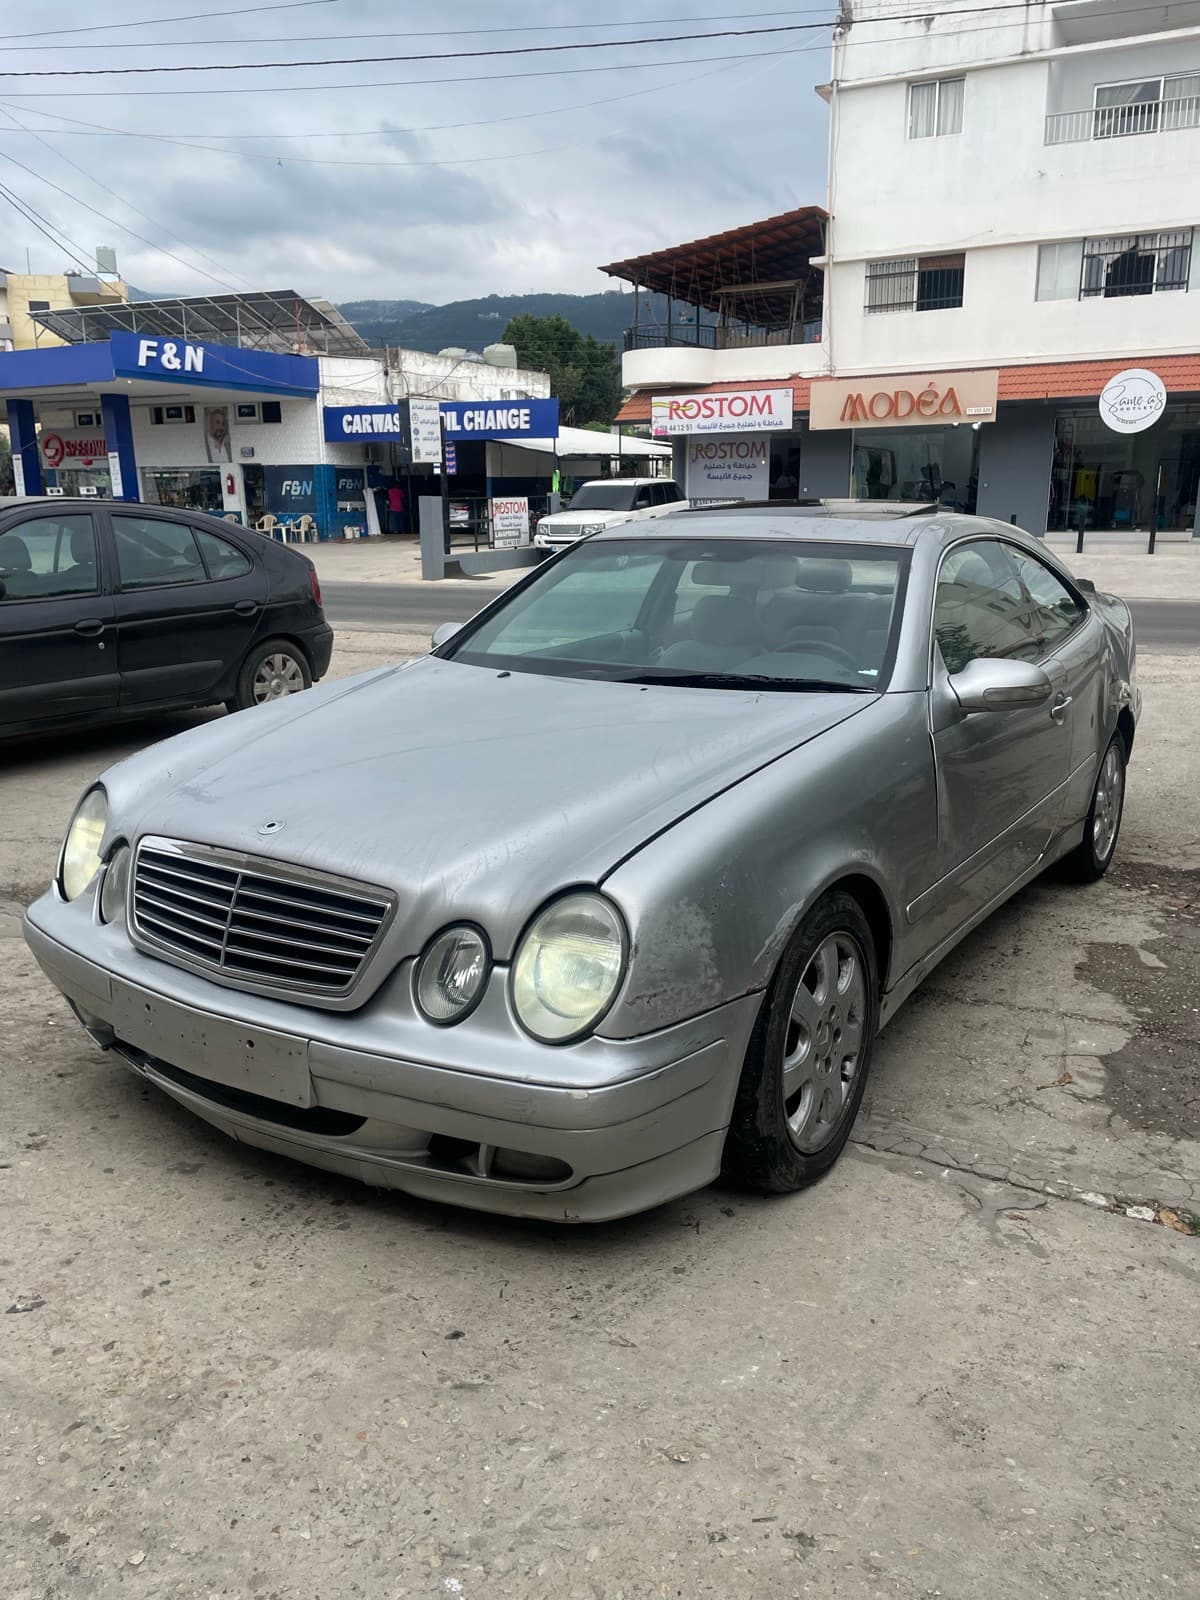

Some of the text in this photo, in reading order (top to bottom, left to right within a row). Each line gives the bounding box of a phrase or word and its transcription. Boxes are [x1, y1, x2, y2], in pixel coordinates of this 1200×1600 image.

[137, 339, 204, 374] F&N
[668, 394, 774, 420] ROSTOM
[464, 408, 531, 431] CHANGE
[694, 441, 767, 460] ROSTOM
[281, 480, 313, 496] F&N
